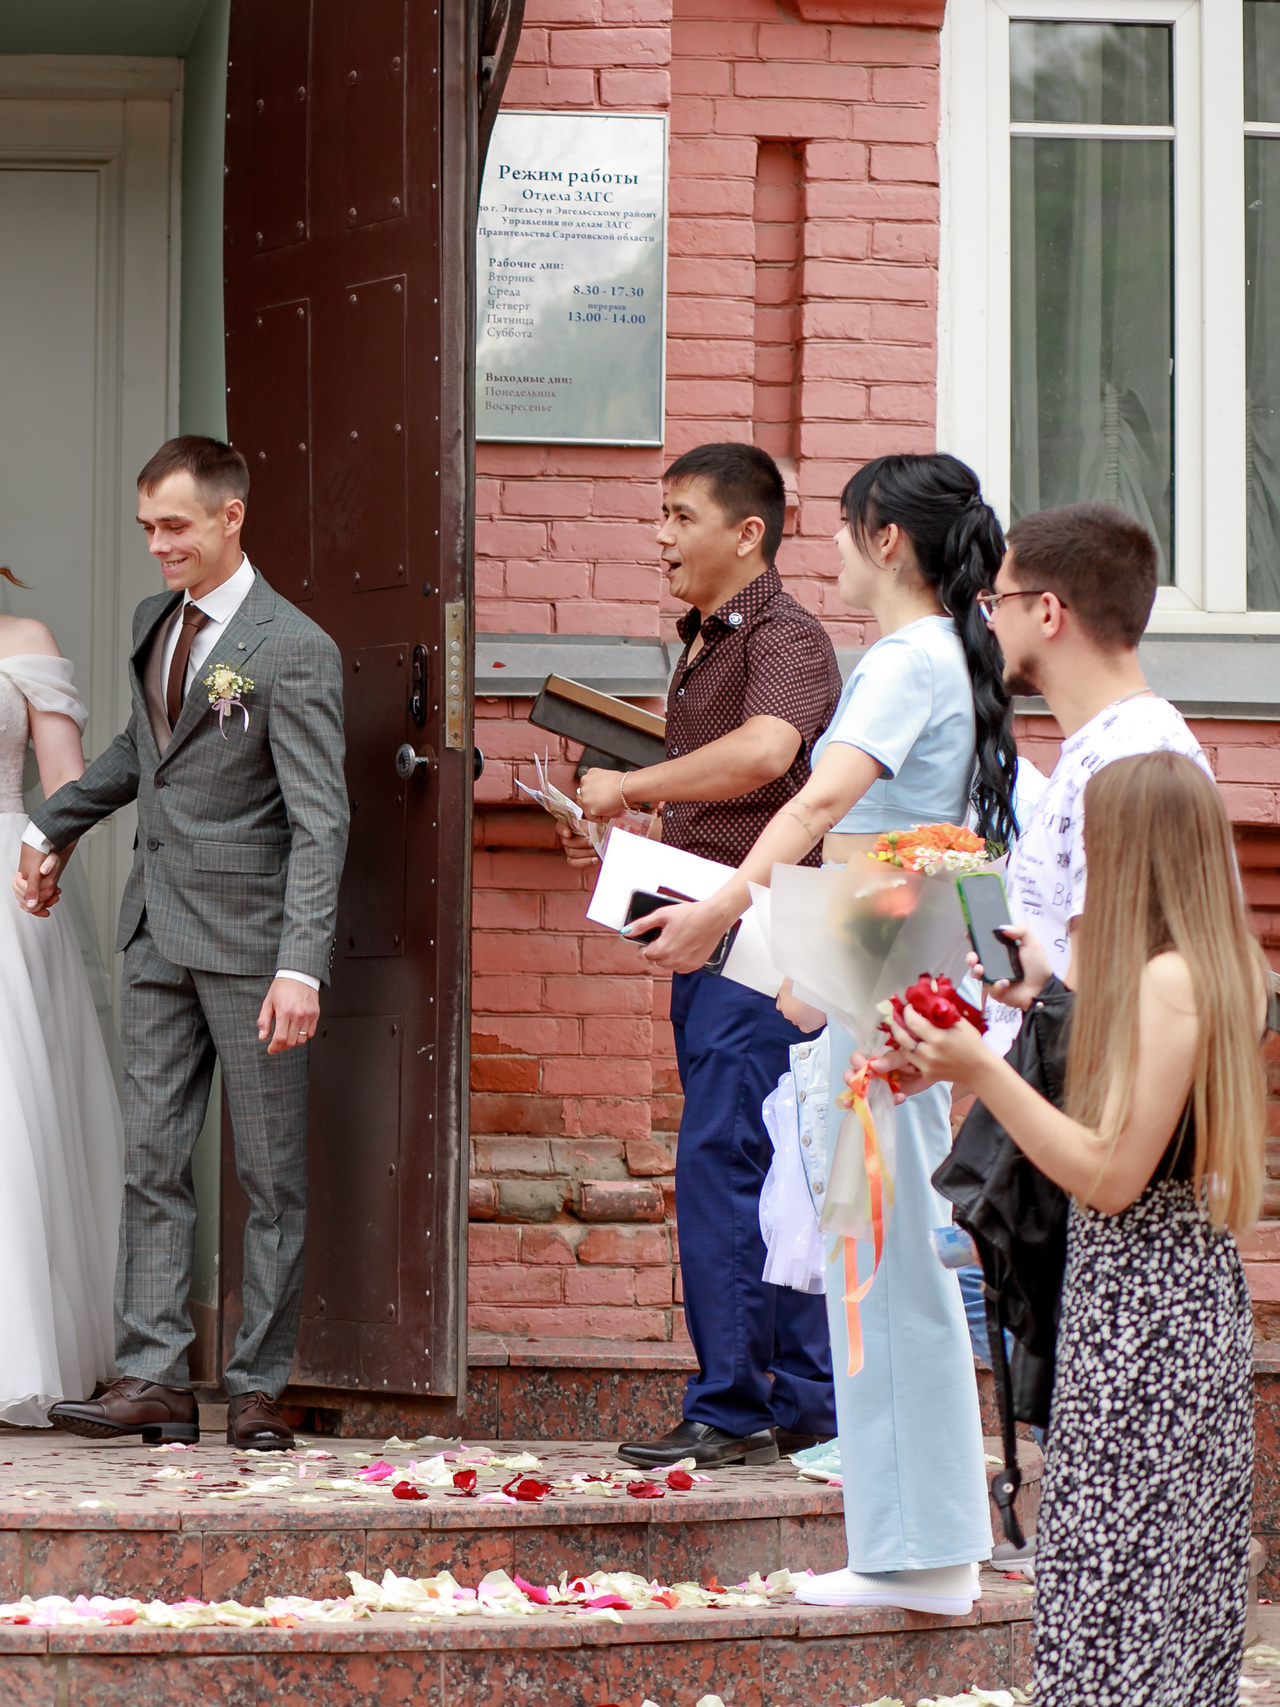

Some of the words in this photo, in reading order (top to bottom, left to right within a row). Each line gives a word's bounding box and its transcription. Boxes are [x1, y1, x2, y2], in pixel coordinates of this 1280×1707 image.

[498, 165, 563, 182] Режим
[568, 168, 639, 187] работы
[522, 188, 571, 202] Отдела
[574, 190, 614, 203] ЗАГС
[500, 204, 544, 215] Энгельсу
[555, 206, 621, 218] Энгельсскому
[623, 210, 658, 220] району
[502, 216, 559, 227] Управления
[575, 221, 603, 229] делам
[604, 221, 632, 230] ЗАГС
[478, 227, 550, 238] Правительства
[552, 230, 615, 241] Саратовской
[616, 232, 655, 243] области
[488, 257, 537, 269] Рабочие
[539, 262, 564, 270] дни:
[487, 271, 535, 285] Вторник
[487, 286, 521, 298] Среда
[573, 284, 600, 296] 8.30
[610, 286, 644, 298] 17.30
[487, 300, 531, 313] Четверг
[587, 302, 627, 312] перерыв
[486, 314, 534, 326] Пятница
[568, 311, 601, 323] 13.00
[612, 313, 646, 324] 14.00
[486, 327, 533, 339] Суббота
[485, 372, 545, 384] Выходные
[485, 386, 557, 398] Понедельник
[485, 400, 552, 414] Воскресенье
